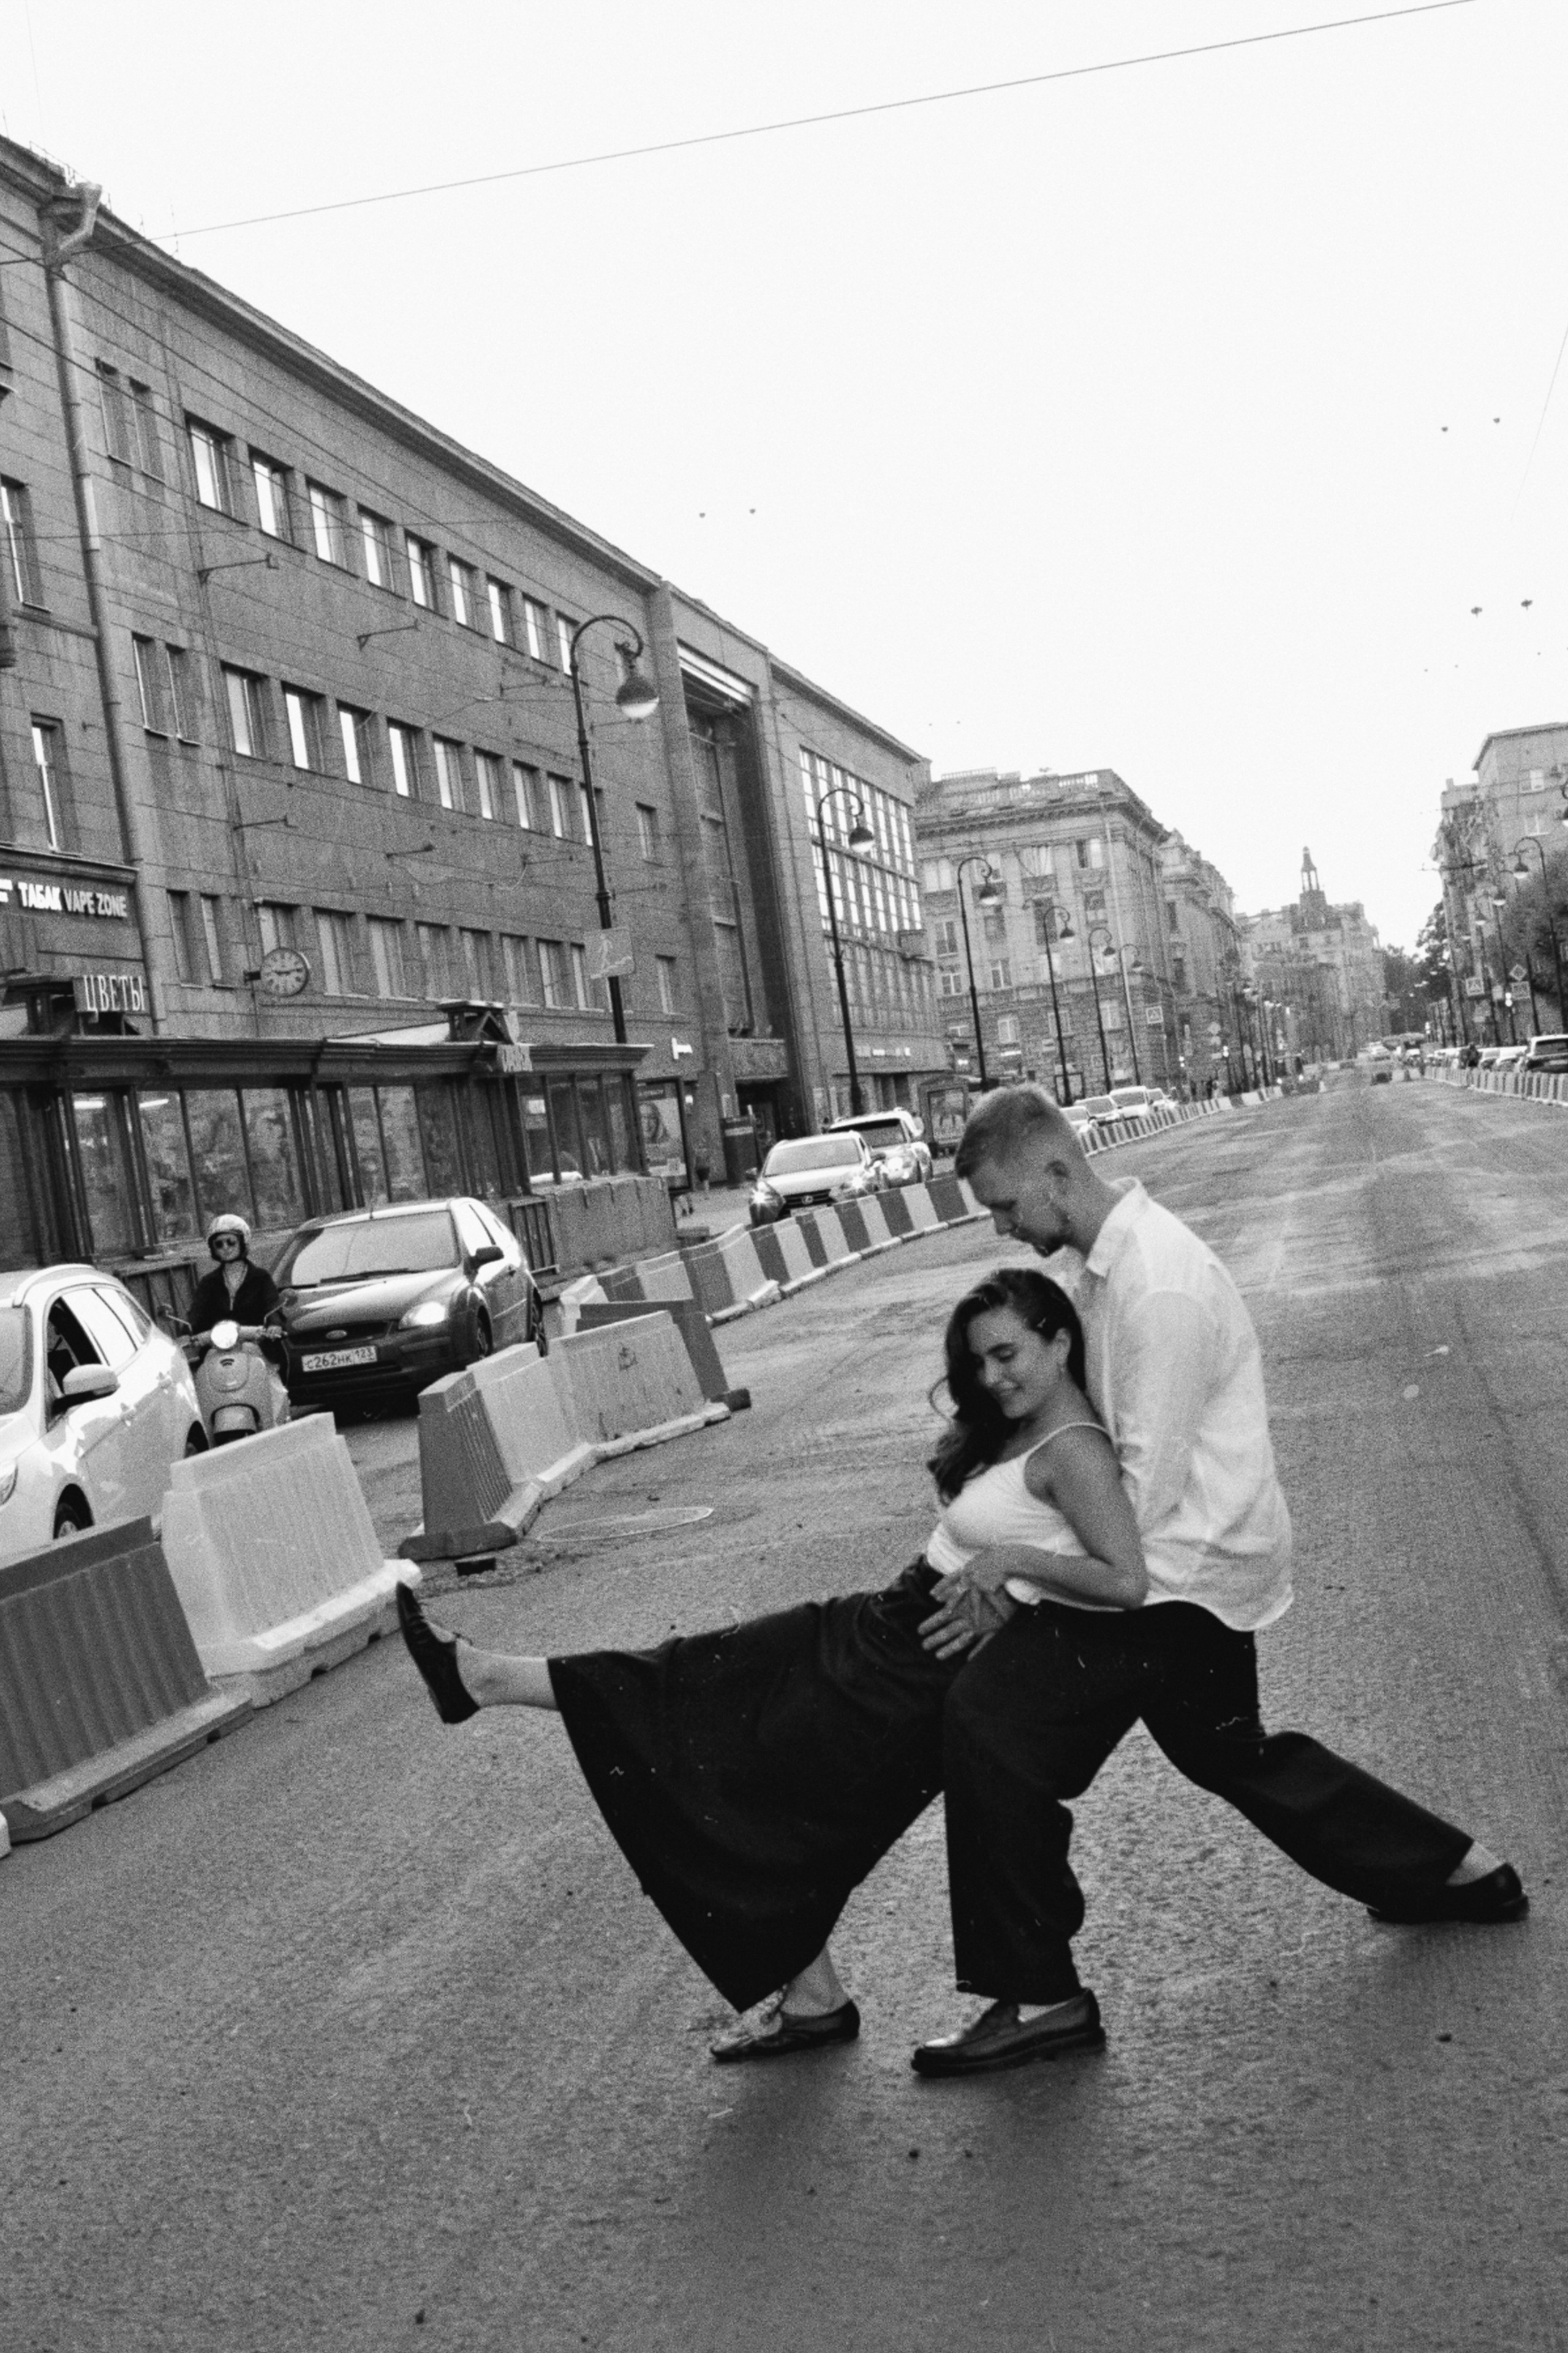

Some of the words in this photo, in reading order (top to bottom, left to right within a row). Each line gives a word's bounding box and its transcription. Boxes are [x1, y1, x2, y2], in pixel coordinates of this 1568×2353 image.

[18, 882, 62, 911] ТАБАК
[63, 888, 95, 915] VAPE
[96, 893, 127, 918] ZONE
[83, 975, 145, 1023] ЦВЕТЫ
